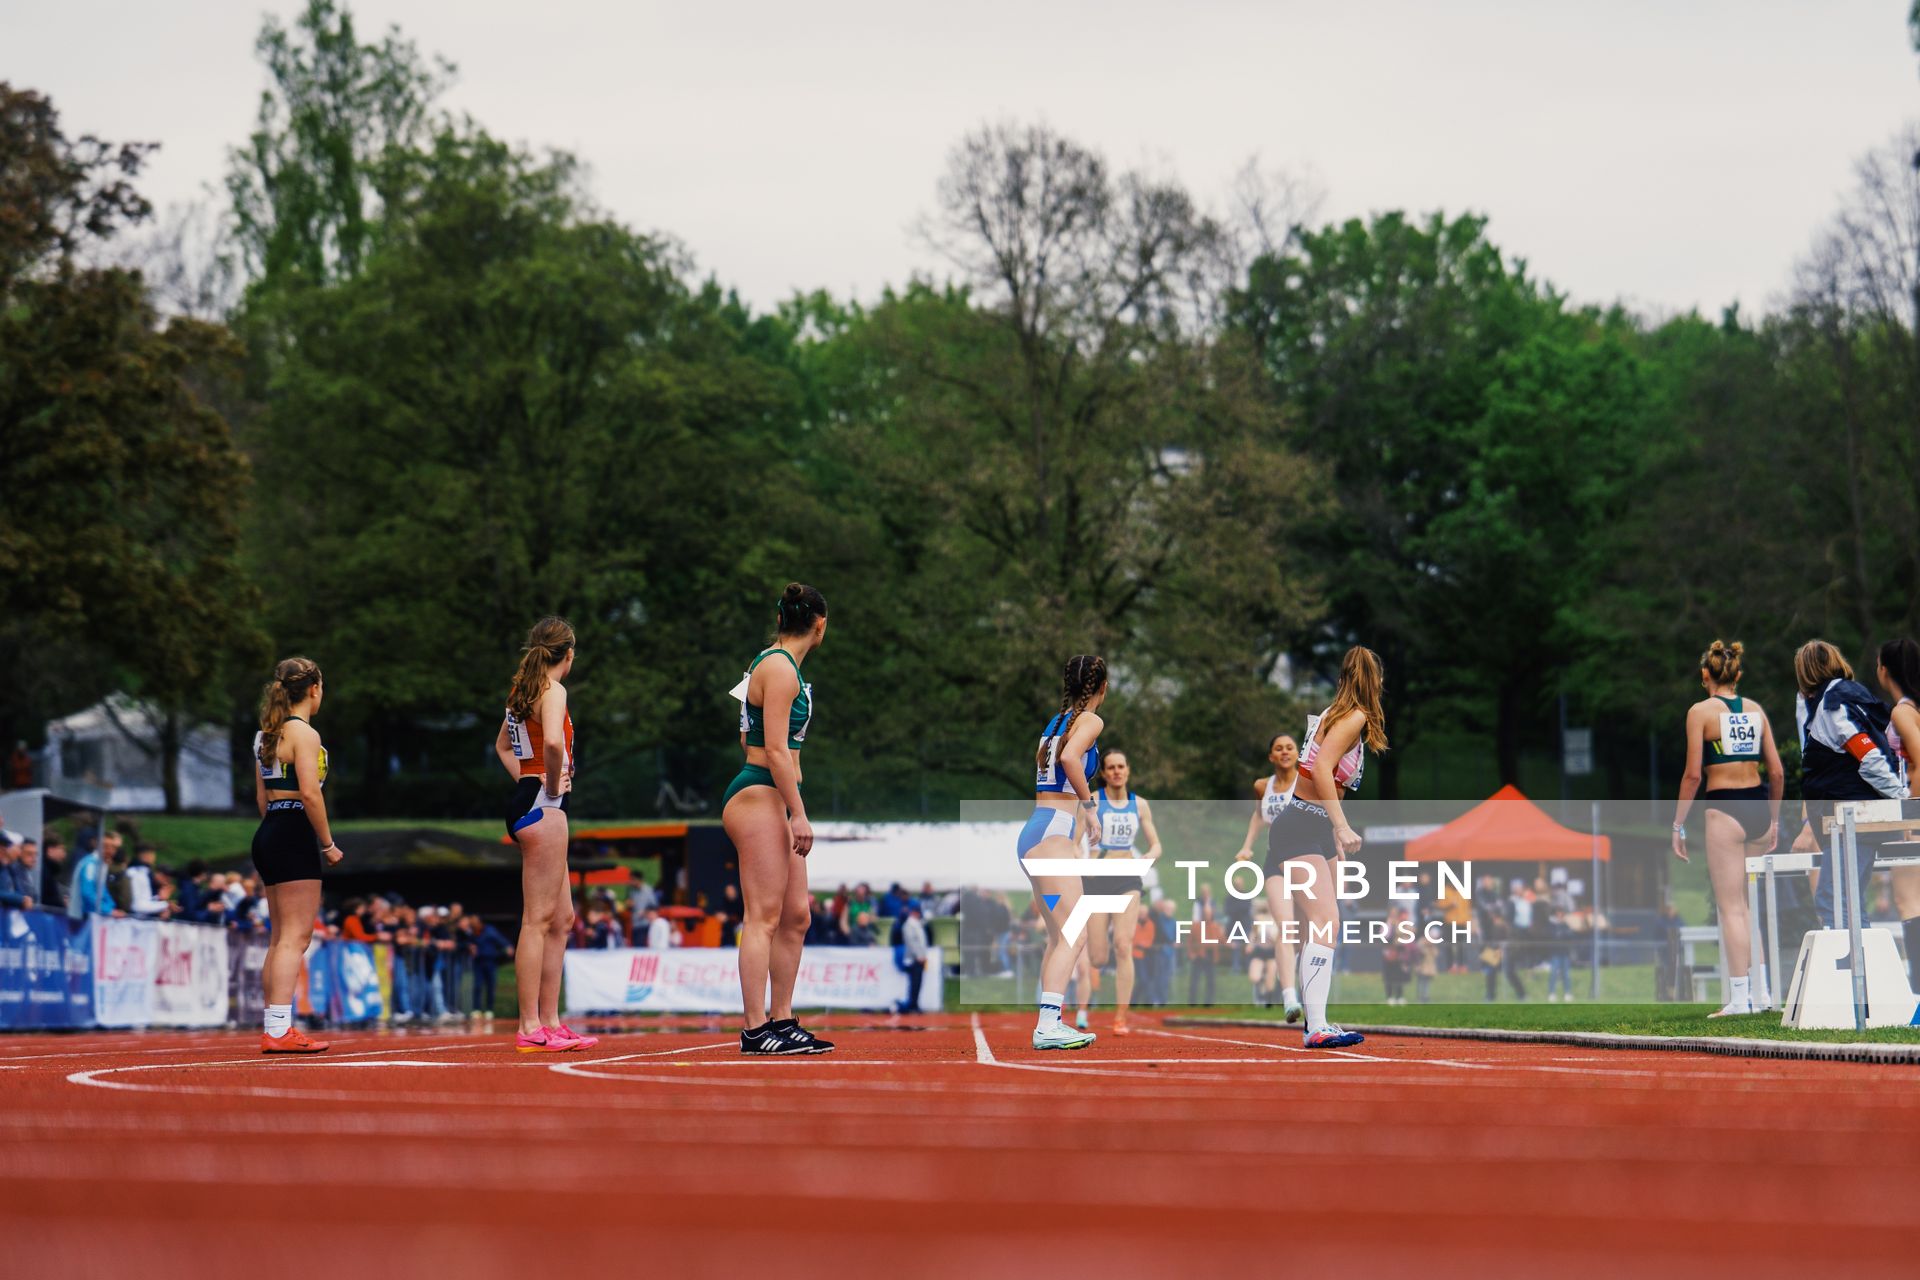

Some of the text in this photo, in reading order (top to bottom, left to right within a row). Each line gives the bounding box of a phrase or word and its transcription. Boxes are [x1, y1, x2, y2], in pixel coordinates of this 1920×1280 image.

[1729, 715, 1748, 724] GLS
[1730, 726, 1755, 740] 464
[1268, 795, 1284, 803] GLS
[1111, 815, 1129, 823] GLS
[1111, 825, 1132, 836] 185
[661, 961, 880, 983] LEICHLETIK
